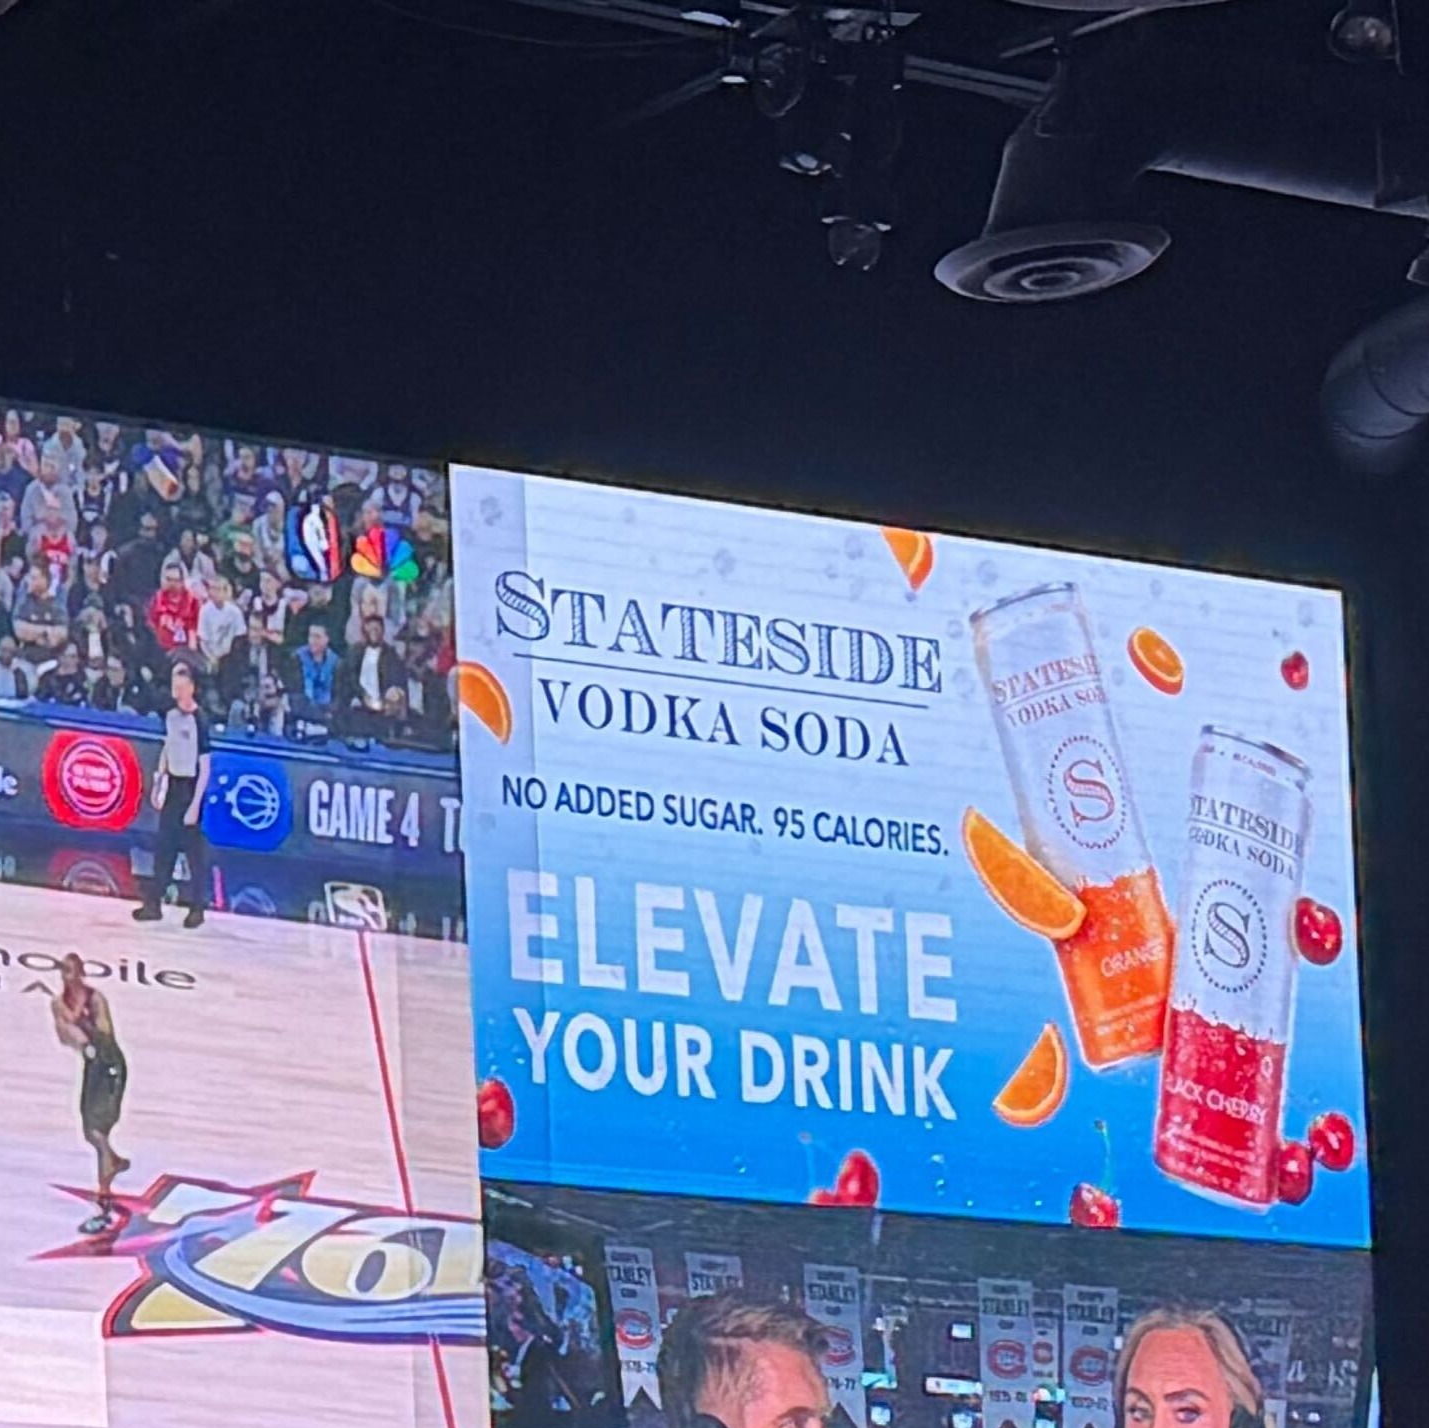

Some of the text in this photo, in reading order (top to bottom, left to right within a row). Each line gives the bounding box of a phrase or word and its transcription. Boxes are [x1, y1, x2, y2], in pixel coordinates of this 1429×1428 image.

[495, 570, 943, 694] STATESIDE
[538, 678, 910, 767] VODKA SODA
[308, 779, 394, 844] GAME
[400, 792, 419, 847] 4
[501, 774, 950, 857] NO ADDED SUGAR. 95 CALORIES.
[507, 868, 959, 1023] ELEVATE
[512, 1007, 958, 1122] YOUR DRINK
